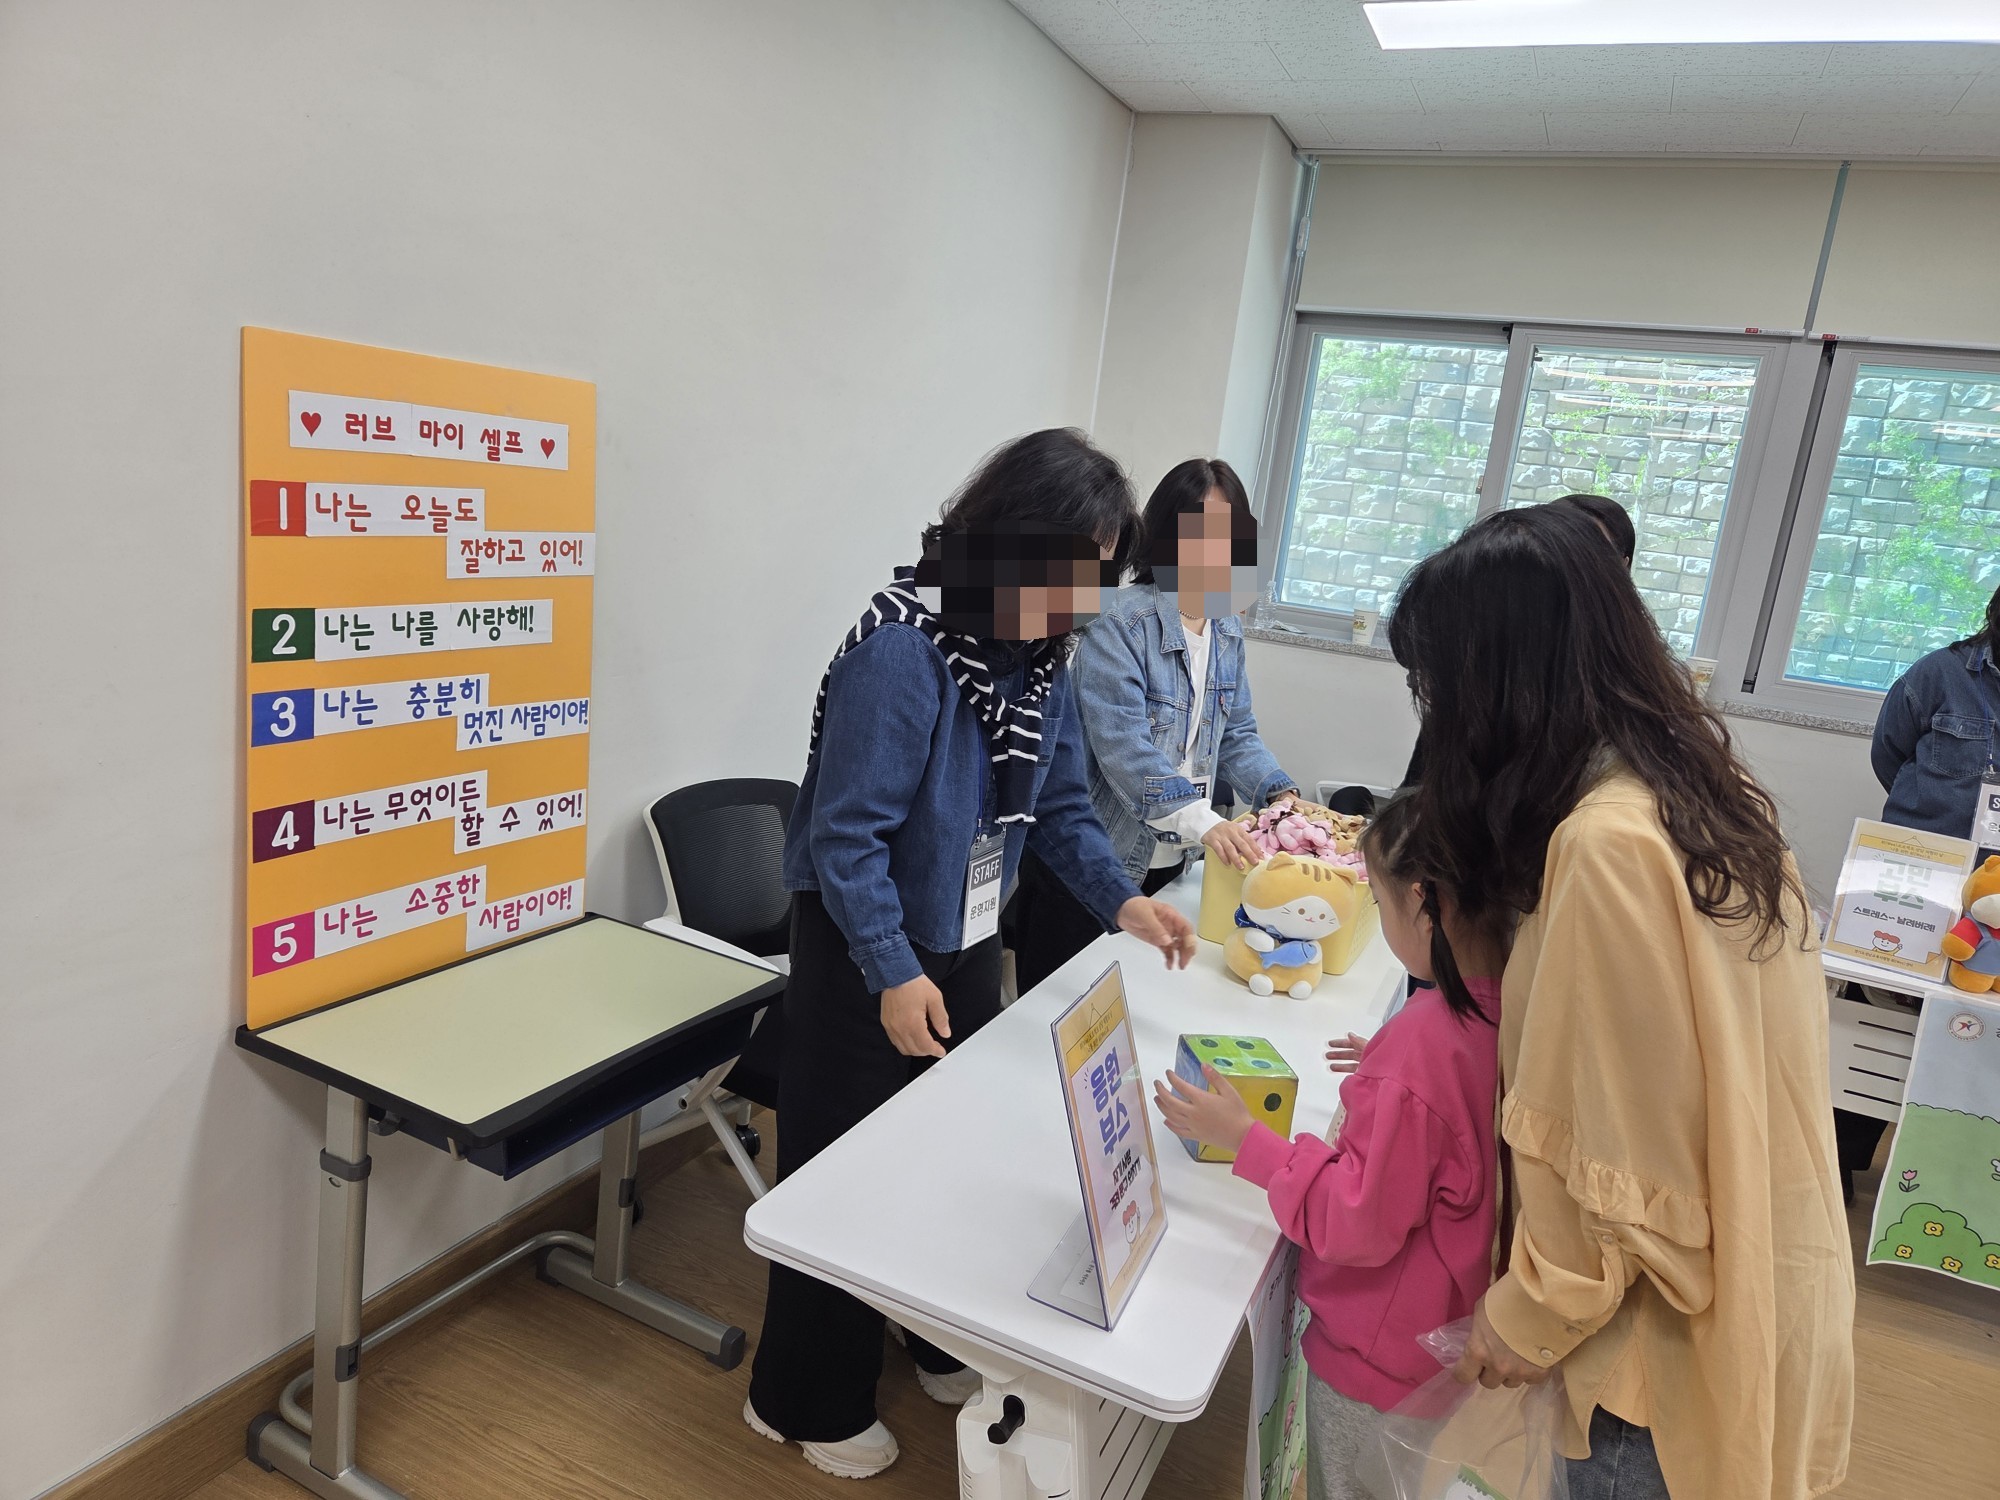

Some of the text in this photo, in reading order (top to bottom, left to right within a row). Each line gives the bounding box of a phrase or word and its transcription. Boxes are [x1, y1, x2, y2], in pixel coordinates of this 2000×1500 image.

[345, 413, 524, 462] 러브 마이 셀프
[279, 487, 478, 534] 1 나는 오늘도
[460, 537, 583, 574] 잘하고 있어!
[271, 604, 535, 655] 2 나는 나를 사랑해!
[270, 678, 481, 738] 3 나는 충분히
[464, 708, 504, 745] 멋진
[270, 778, 480, 851] 4 나는 무엇이든
[460, 792, 583, 847] 할 수 있어!
[973, 859, 1000, 885] STAFF
[1874, 880, 1924, 910] 부스
[1879, 858, 1932, 888] 고민
[271, 873, 480, 964] 5 나는 소중한
[478, 885, 573, 933] 사람이야!
[970, 896, 997, 921] 운영지원
[1090, 1046, 1122, 1113] 응원
[1099, 1096, 1131, 1157] 부스
